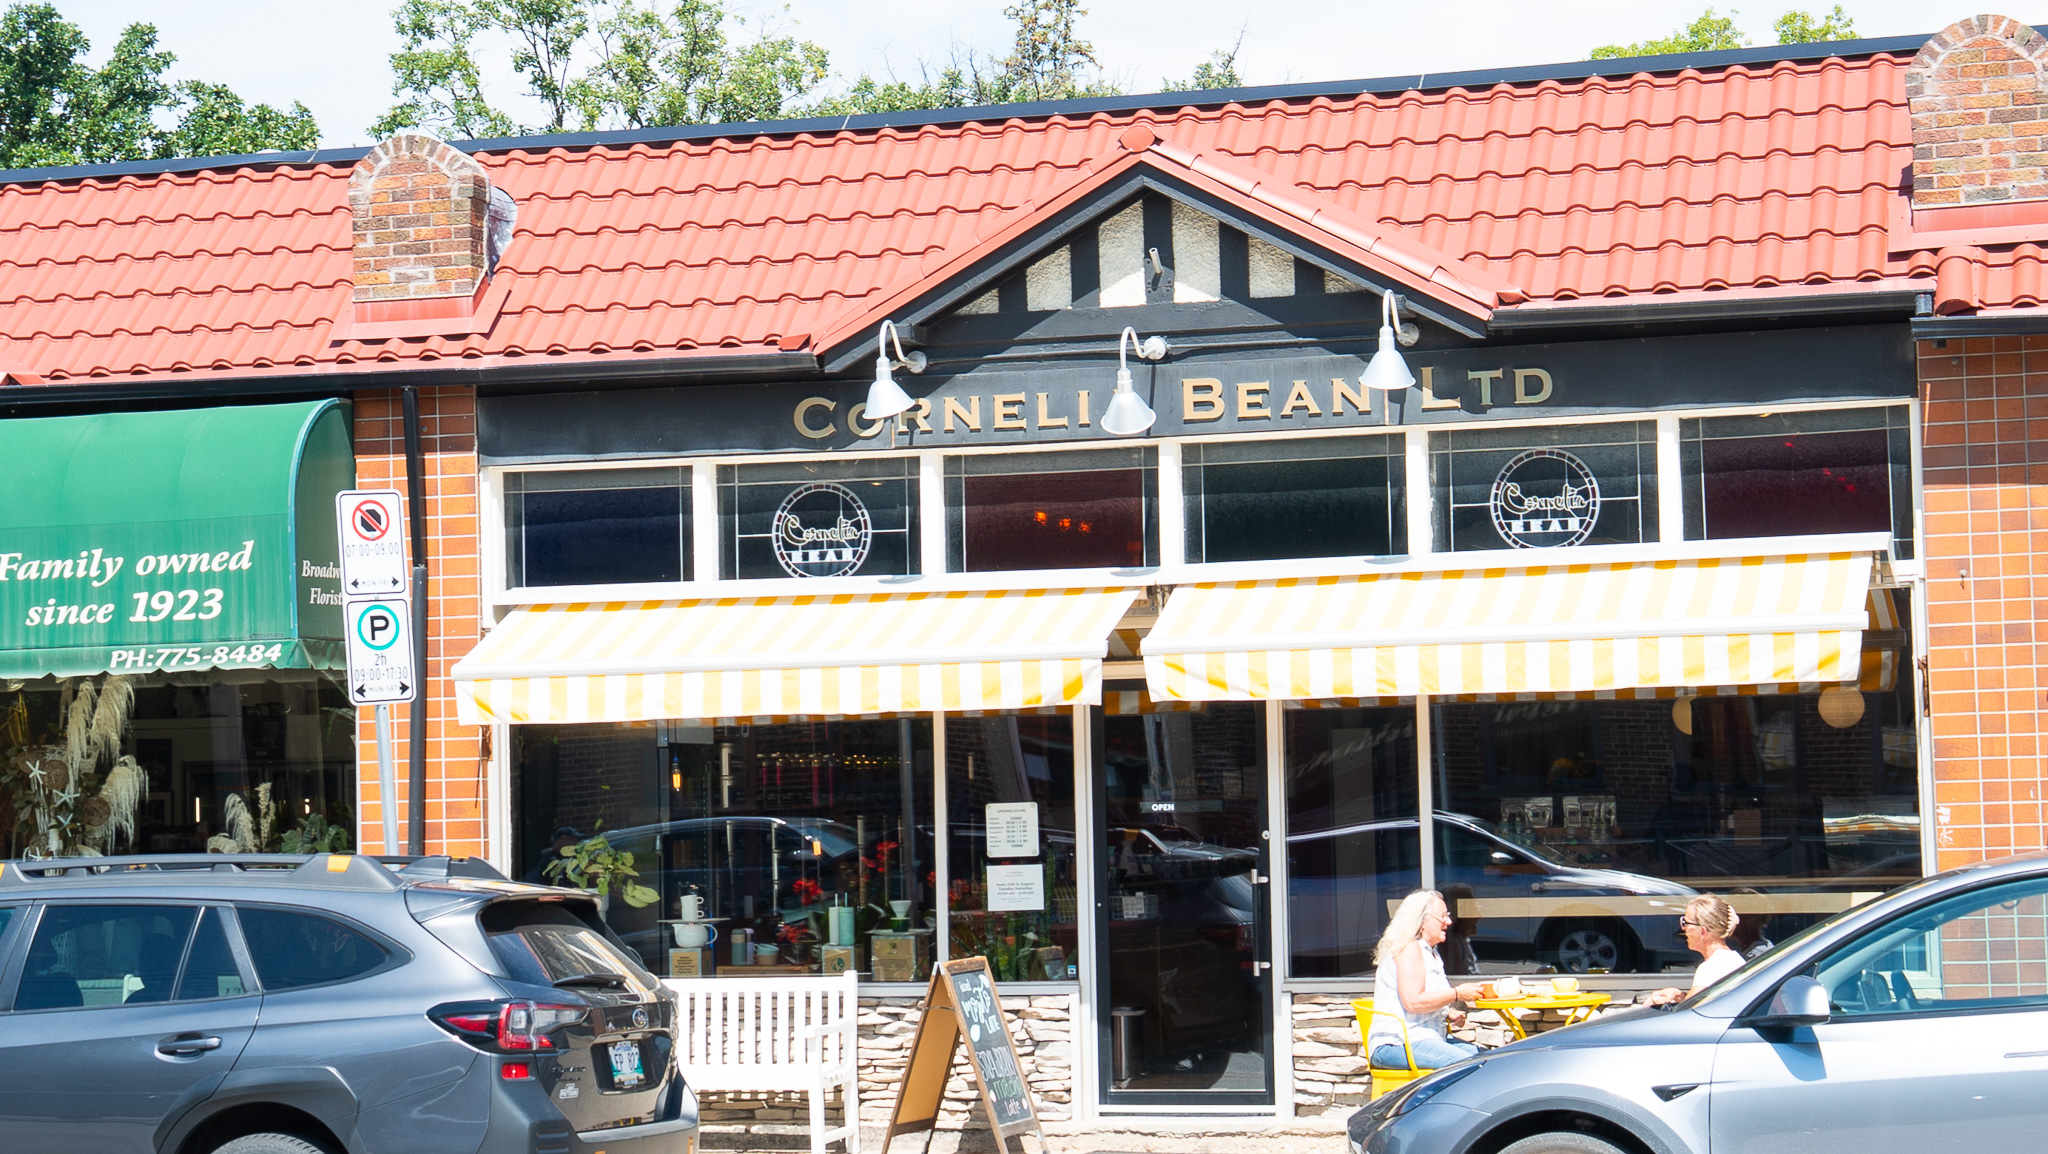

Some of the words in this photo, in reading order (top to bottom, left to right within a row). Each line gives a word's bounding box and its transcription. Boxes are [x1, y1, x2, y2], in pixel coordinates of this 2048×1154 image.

[793, 389, 1092, 440] CORNELI
[1181, 377, 1371, 422] BEAN
[1420, 366, 1553, 410] LTD
[345, 541, 399, 558] 07:00-09:00
[0, 547, 124, 588] Family
[135, 539, 255, 577] owned
[301, 559, 341, 579] Broadw
[25, 597, 116, 627] since
[128, 587, 224, 623] 1923
[369, 614, 390, 641] P
[109, 642, 282, 669] PH:775-8484
[374, 652, 387, 666] 2h
[354, 666, 409, 682] 09:00-17:30
[1151, 803, 1175, 812] OPEN
